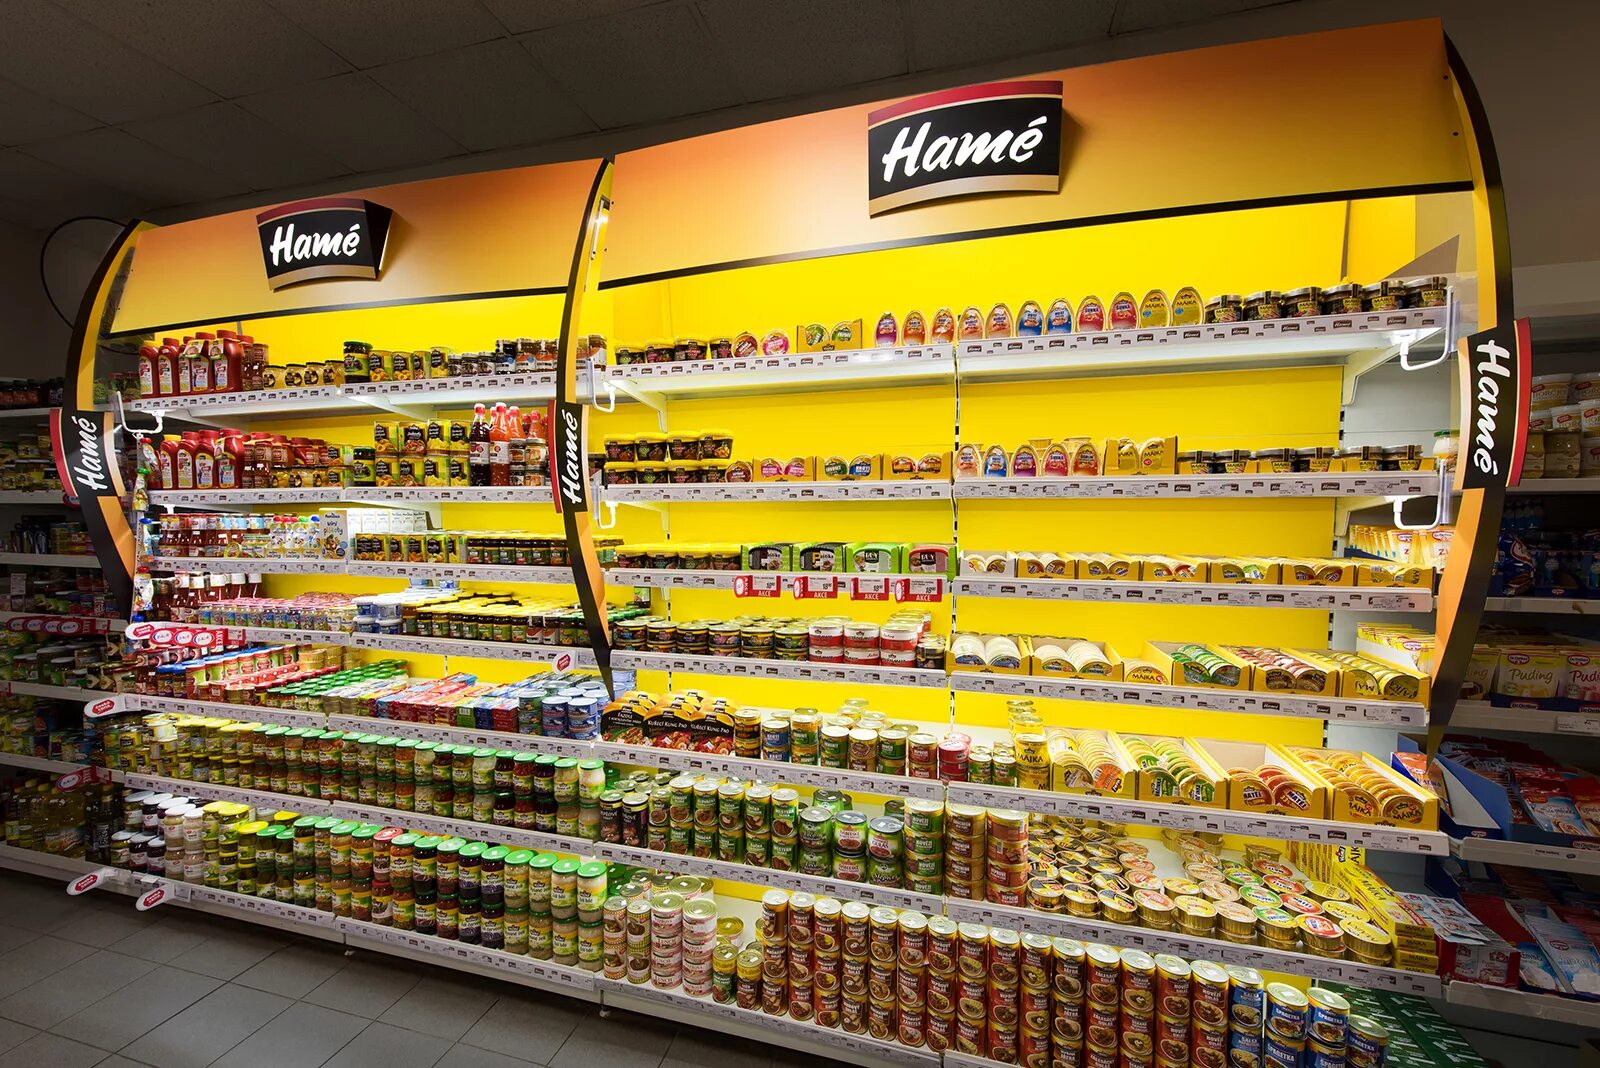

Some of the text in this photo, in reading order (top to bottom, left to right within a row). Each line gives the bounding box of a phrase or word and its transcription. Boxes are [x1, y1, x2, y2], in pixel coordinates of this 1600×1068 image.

[882, 115, 1047, 183] Hamé
[269, 223, 360, 267] Hamé
[1473, 339, 1511, 476] Hamé
[71, 416, 108, 490] Hamé
[561, 409, 582, 504] Hamé
[1509, 668, 1553, 684] Puding
